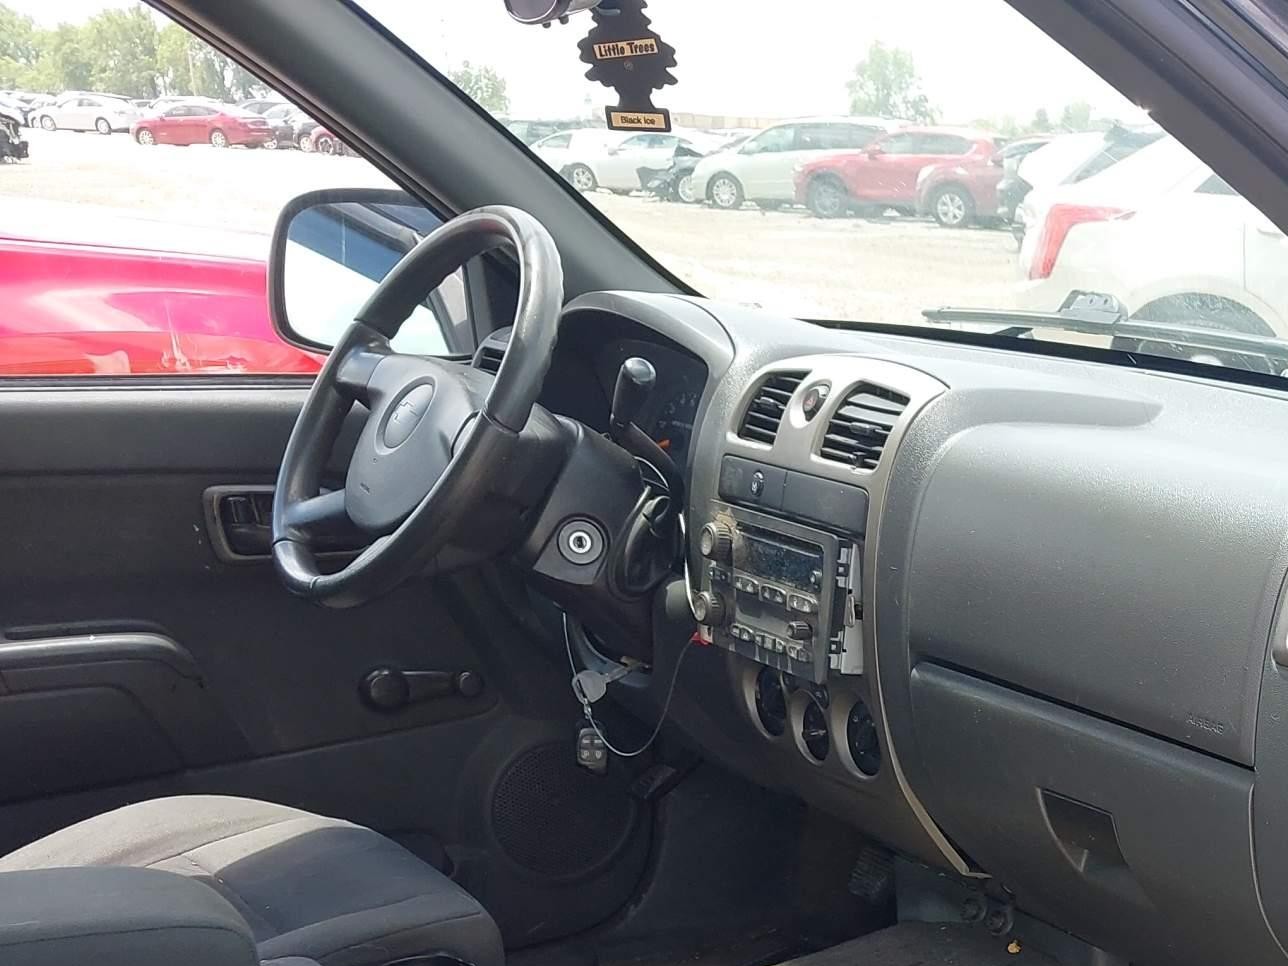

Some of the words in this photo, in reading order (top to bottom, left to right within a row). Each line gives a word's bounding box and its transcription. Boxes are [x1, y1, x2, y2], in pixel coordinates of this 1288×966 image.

[598, 44, 625, 58] Little
[626, 42, 655, 54] Trees
[620, 115, 642, 125] Black
[643, 116, 656, 125] Ice
